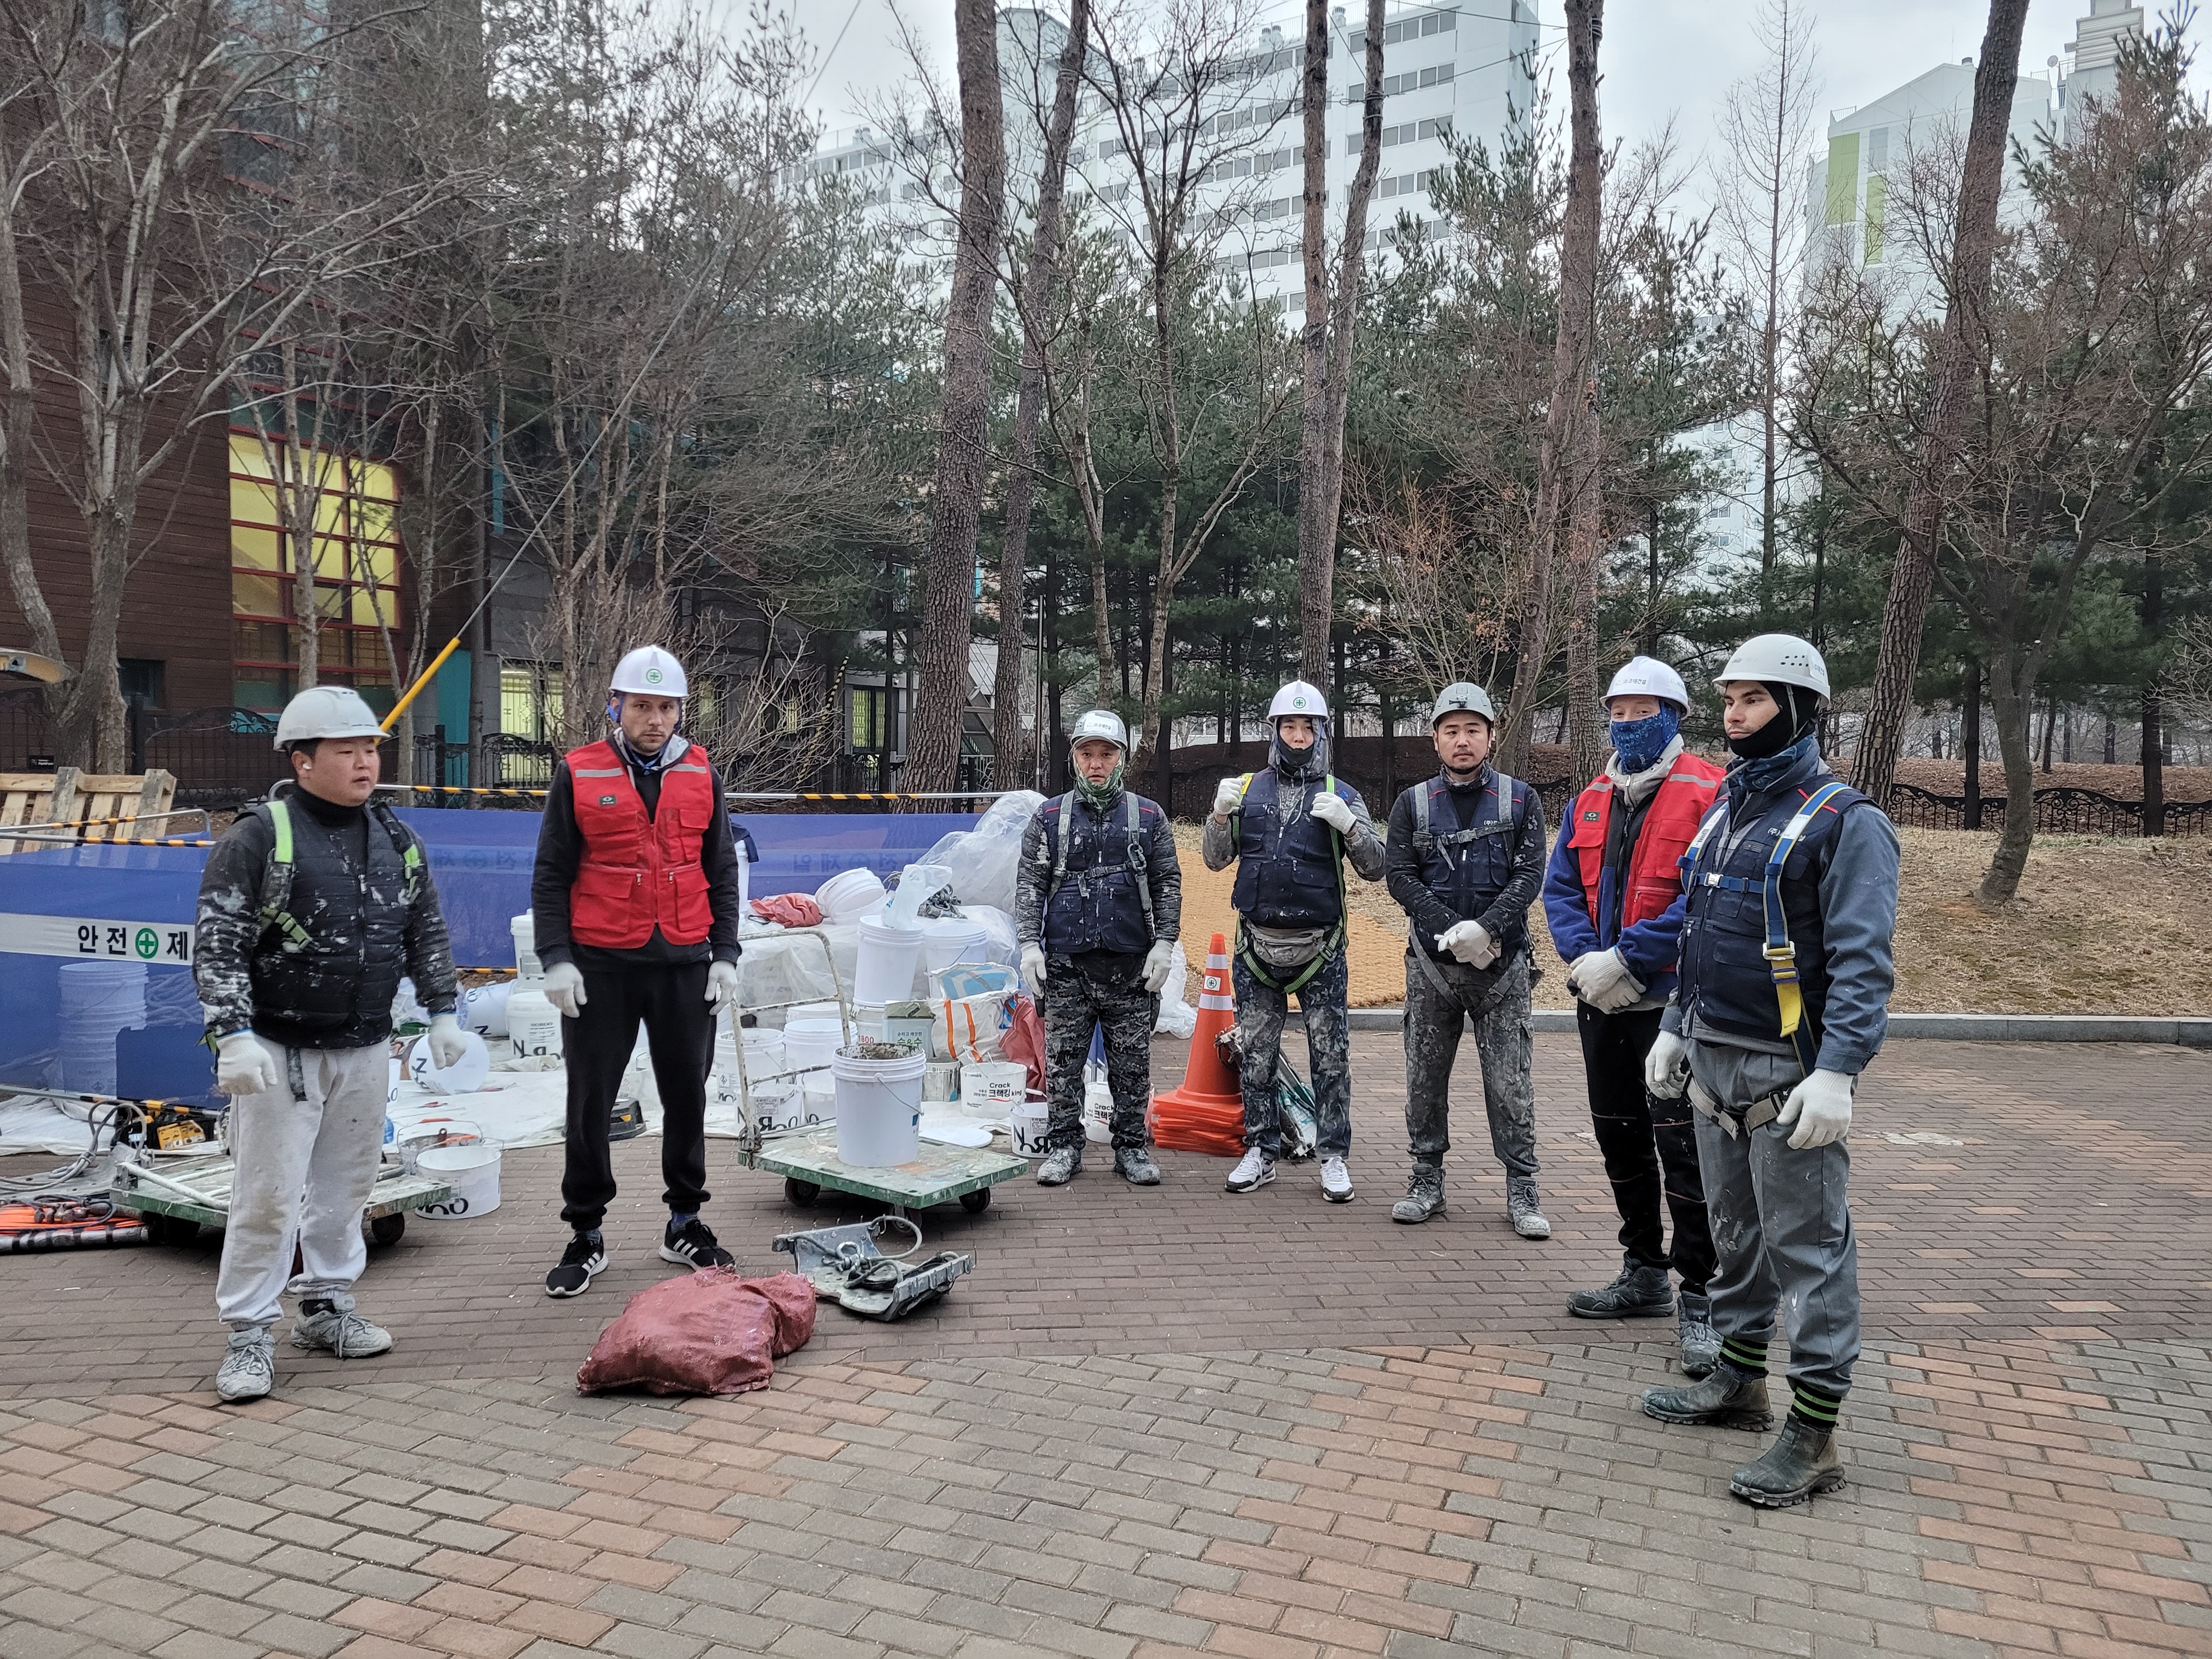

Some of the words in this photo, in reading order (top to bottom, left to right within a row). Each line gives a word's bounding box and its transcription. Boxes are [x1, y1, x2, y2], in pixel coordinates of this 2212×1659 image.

[78, 925, 126, 955] 안전
[166, 931, 188, 961] 제
[858, 1035, 874, 1044] 1800
[988, 1089, 1011, 1098] 크랙킹
